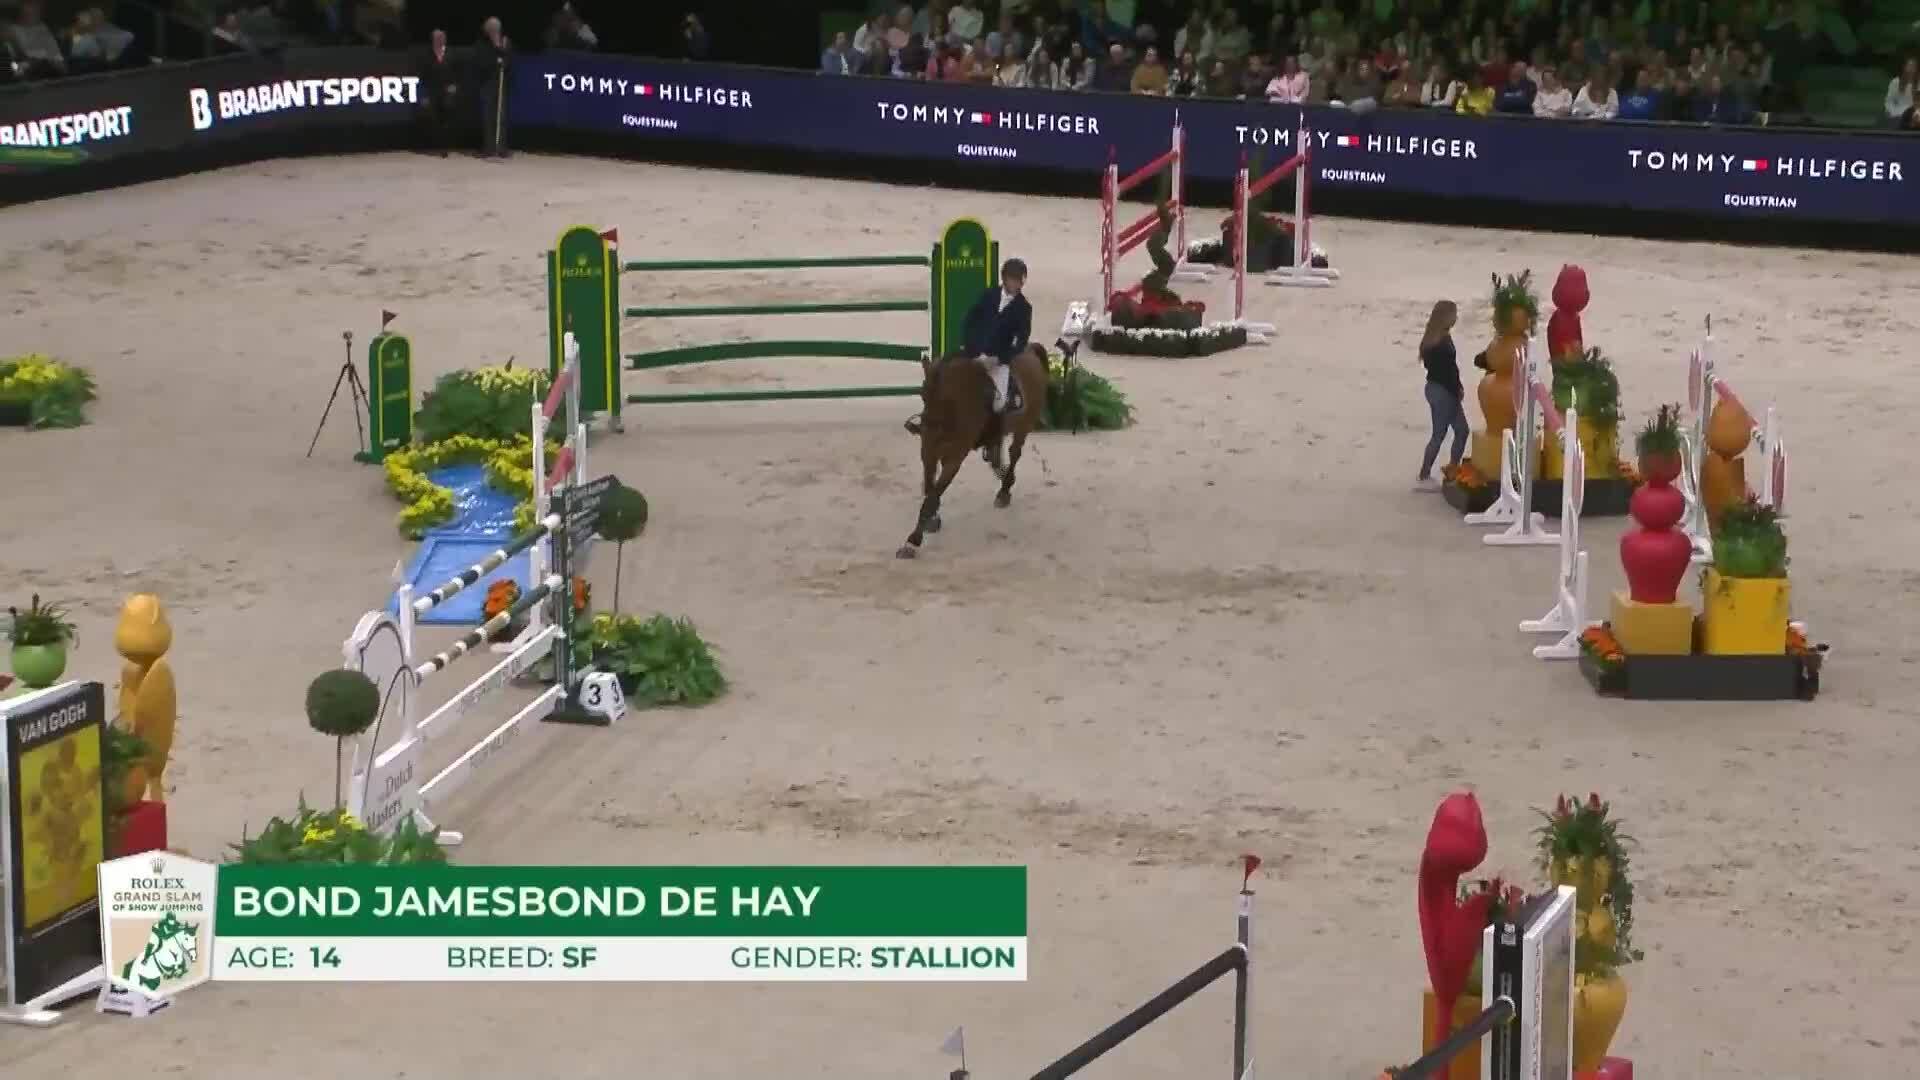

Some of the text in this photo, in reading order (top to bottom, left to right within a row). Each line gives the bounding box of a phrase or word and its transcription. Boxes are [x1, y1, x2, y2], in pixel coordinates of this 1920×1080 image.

[219, 76, 420, 119] BRABANTSPORT
[543, 73, 753, 108] TOMMY HILFIGER
[622, 114, 678, 129] EQUESTRIAN
[877, 102, 1100, 135] TOMMY HILFIGER
[957, 144, 1017, 158] EQUESTRIAN
[1367, 134, 1478, 159] HILFIGER
[1321, 168, 1386, 184] EQUESTRIAN
[1628, 150, 1903, 181] TOMMY HILFIGER
[1724, 194, 1797, 208] EQUESTRIAN
[588, 684, 601, 706] 3
[19, 701, 87, 743] VAN GOGH
